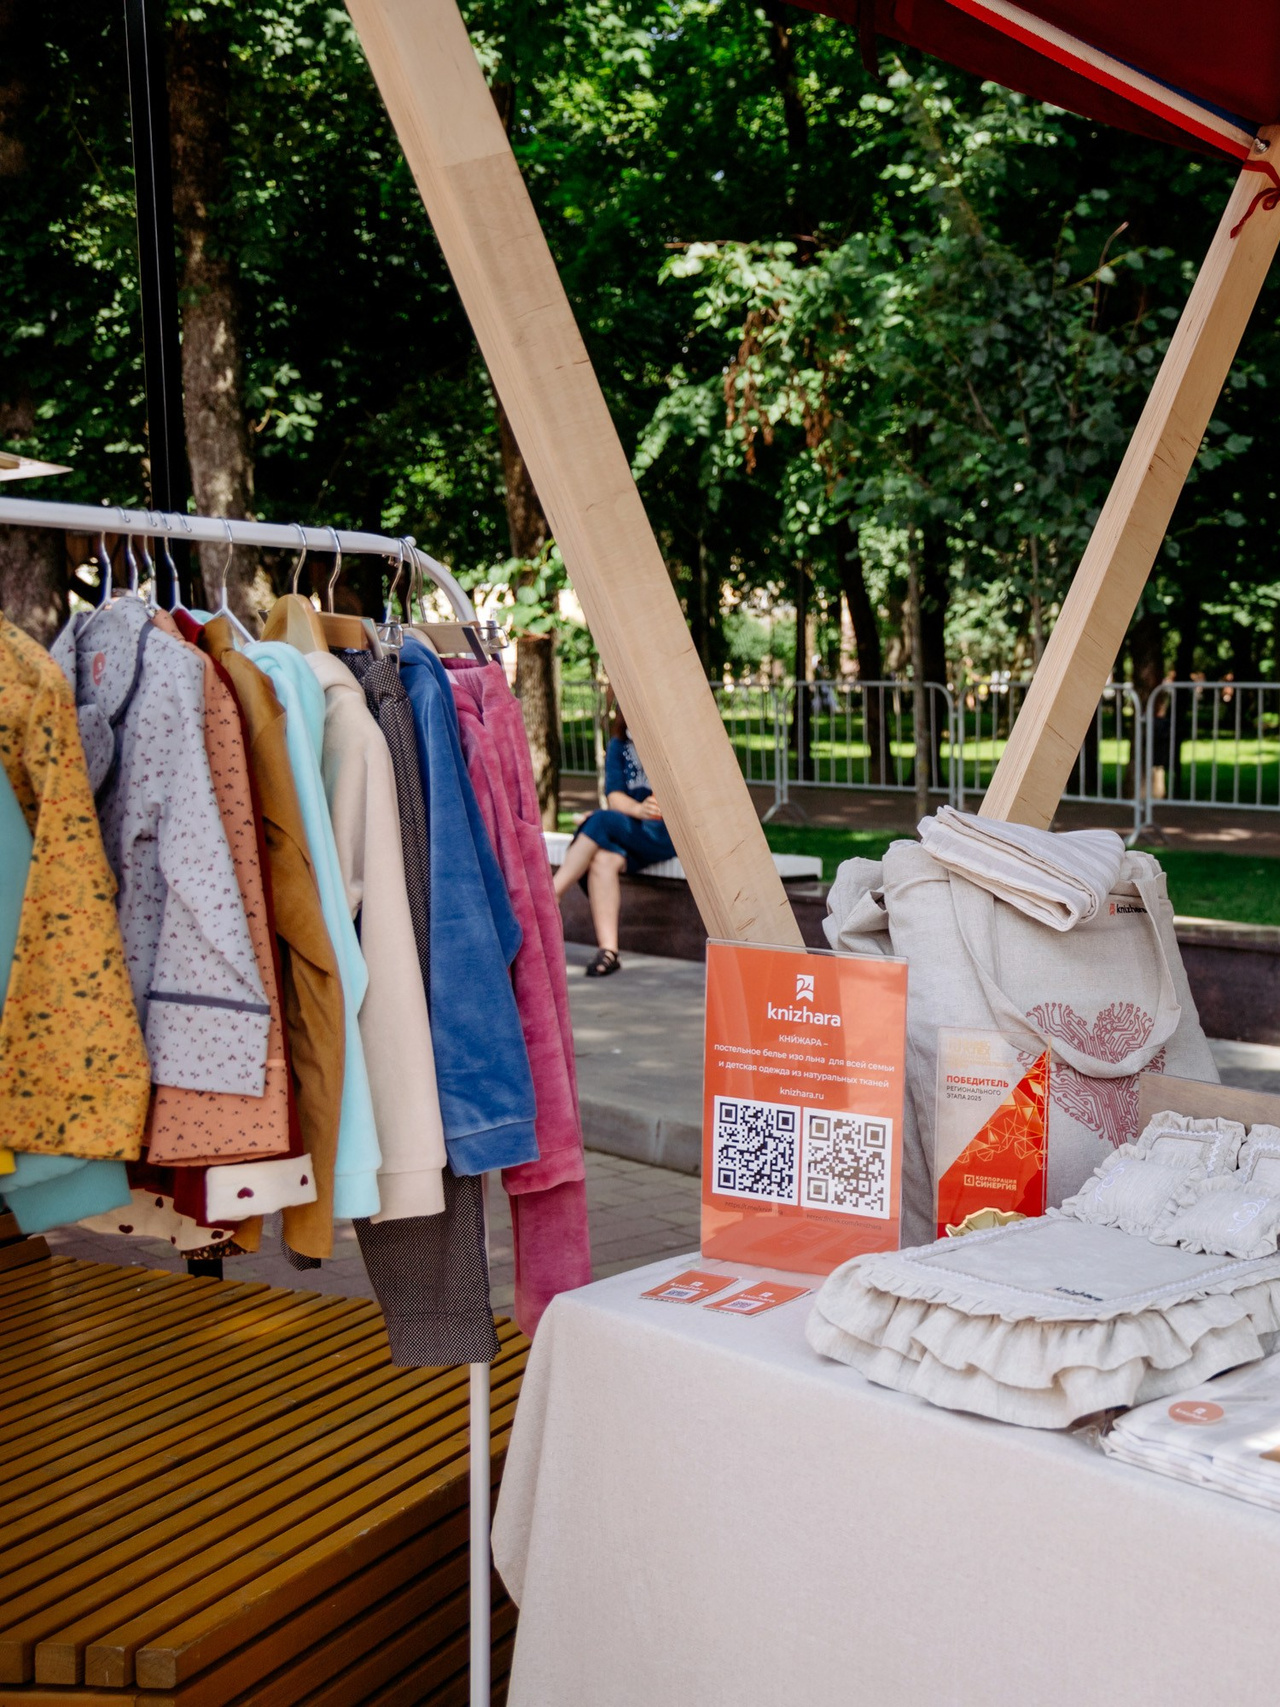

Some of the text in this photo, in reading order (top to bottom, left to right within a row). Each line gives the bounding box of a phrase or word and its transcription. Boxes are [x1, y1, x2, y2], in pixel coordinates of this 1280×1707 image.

[767, 1001, 841, 1027] knizhara
[714, 1044, 895, 1072] постельное белье изо льна для всей семьи
[725, 1061, 757, 1071] детская
[758, 1065, 790, 1076] одежда
[791, 1069, 802, 1077] из
[803, 1072, 857, 1084] натуральных
[859, 1077, 889, 1088] тканей
[946, 1075, 1009, 1088] ПОБЕДИТЕЛЬ
[779, 1086, 824, 1100] knizhara.ru
[946, 1085, 1001, 1096] РЕГИОНАЛЬНОГО
[946, 1092, 982, 1102] ЭТАПА 2025
[975, 1175, 1017, 1184] КОРПОРАЦИЯ
[975, 1180, 1017, 1191] СИНЕРГИЯ
